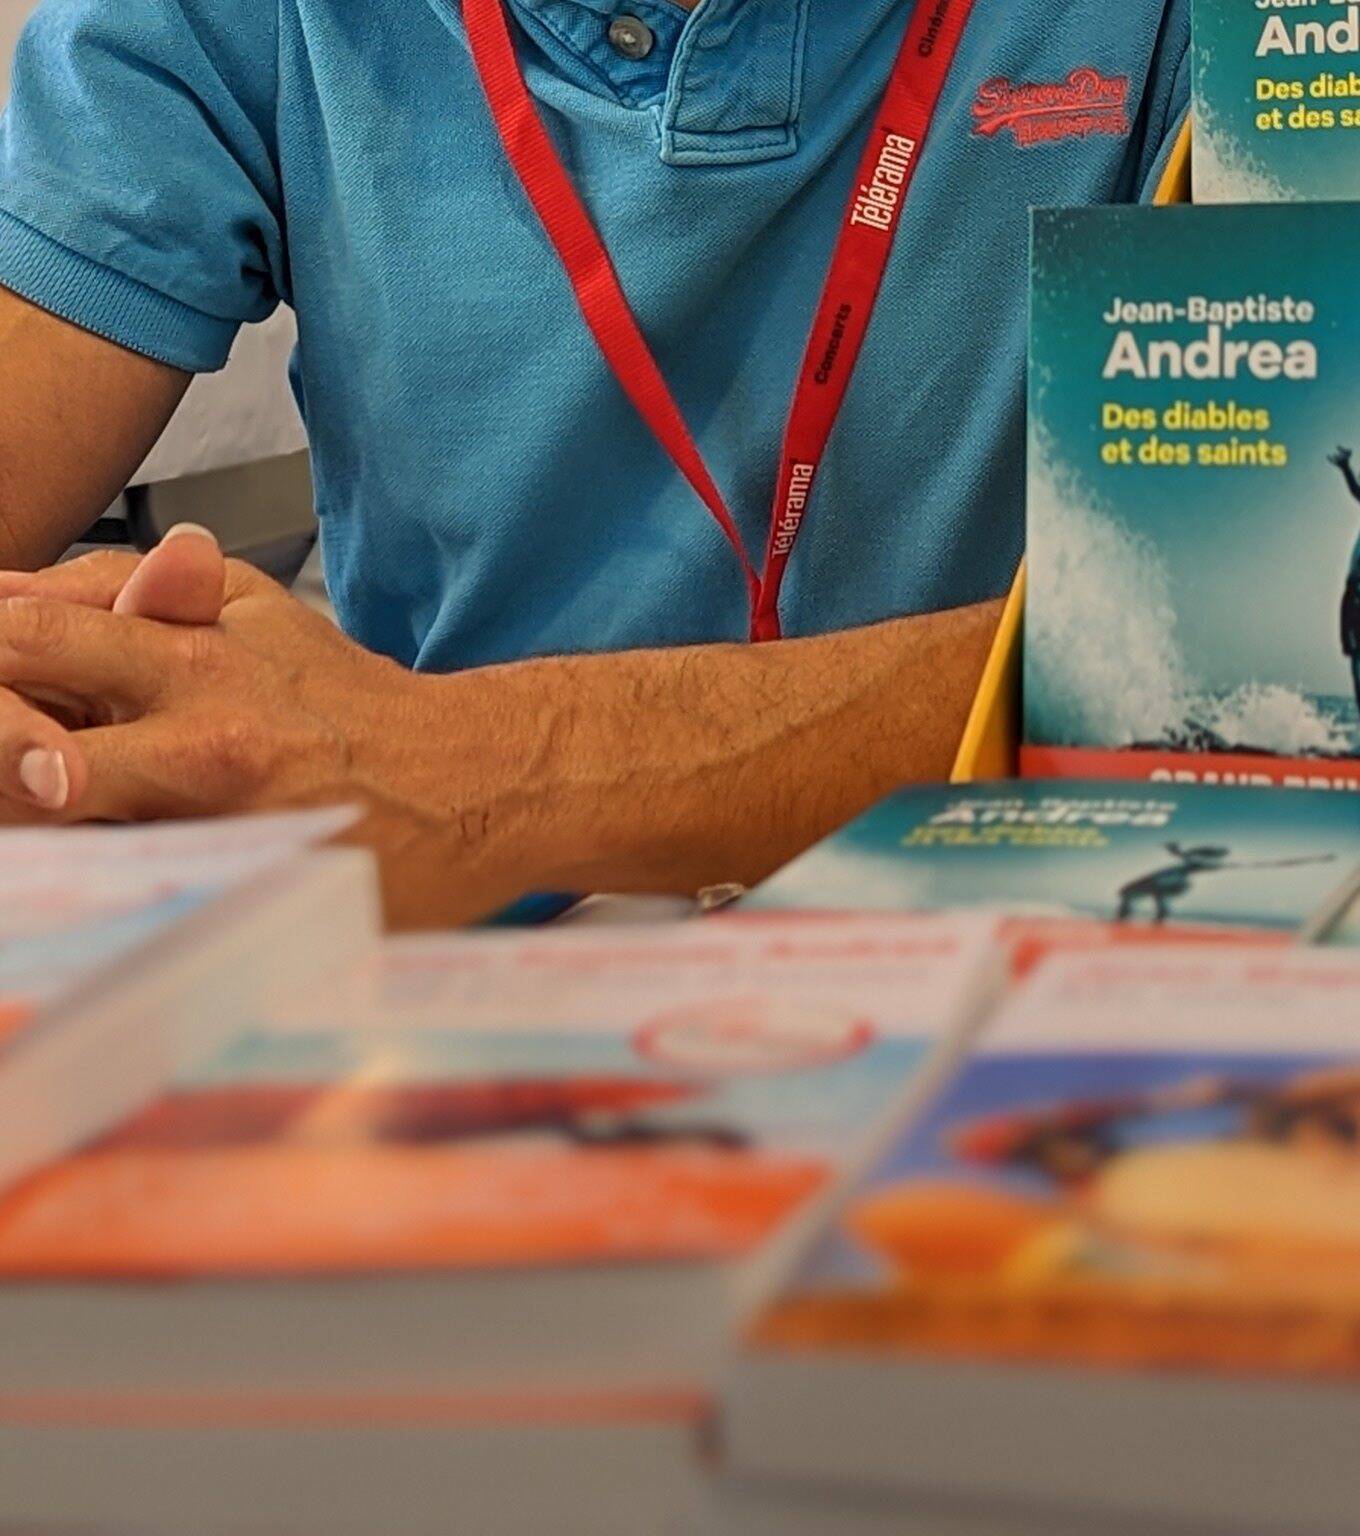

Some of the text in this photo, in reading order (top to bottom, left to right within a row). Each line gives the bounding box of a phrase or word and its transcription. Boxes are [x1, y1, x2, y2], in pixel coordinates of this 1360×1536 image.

[1255, 76, 1304, 101] Des
[1255, 107, 1284, 130] et
[1288, 104, 1335, 129] des
[850, 133, 916, 232] Télérama
[1102, 293, 1315, 329] Jean-Baptiste
[1101, 325, 1317, 380] Andrea
[1101, 400, 1270, 431] Des diables
[1101, 436, 1288, 466] et des saints
[772, 463, 814, 559] Télérama
